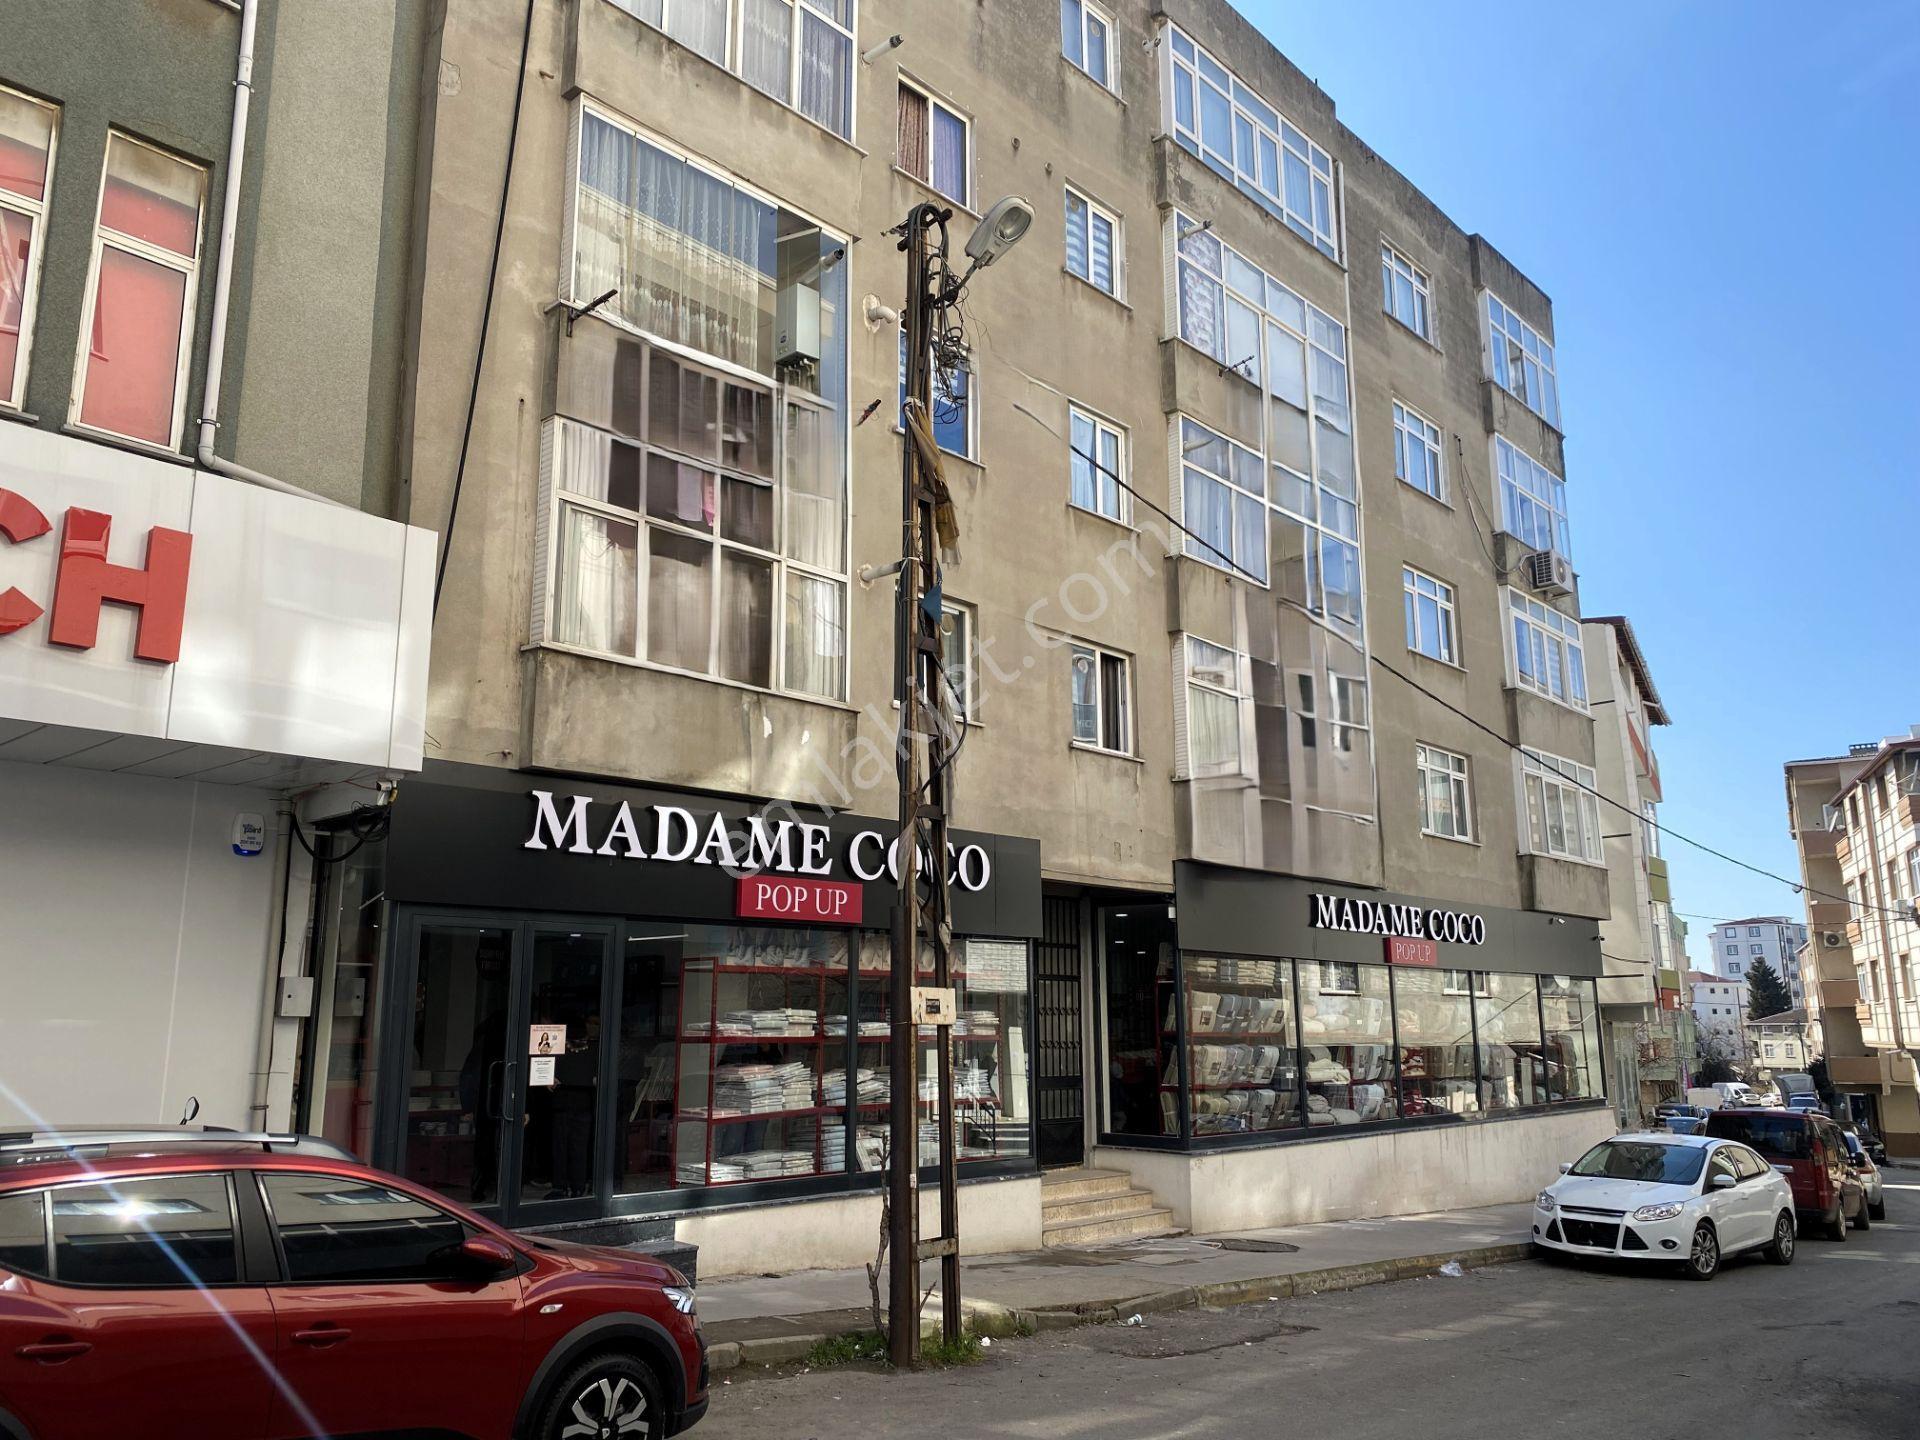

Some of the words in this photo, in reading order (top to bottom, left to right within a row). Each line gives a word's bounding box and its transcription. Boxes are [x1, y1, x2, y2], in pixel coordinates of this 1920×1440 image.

[524, 790, 834, 875] MADAME
[755, 883, 808, 913] POP
[814, 887, 848, 916] UP
[1315, 893, 1425, 938] MADAME
[1429, 909, 1486, 946] COCO
[1396, 942, 1416, 961] POP
[1418, 944, 1431, 962] UP
